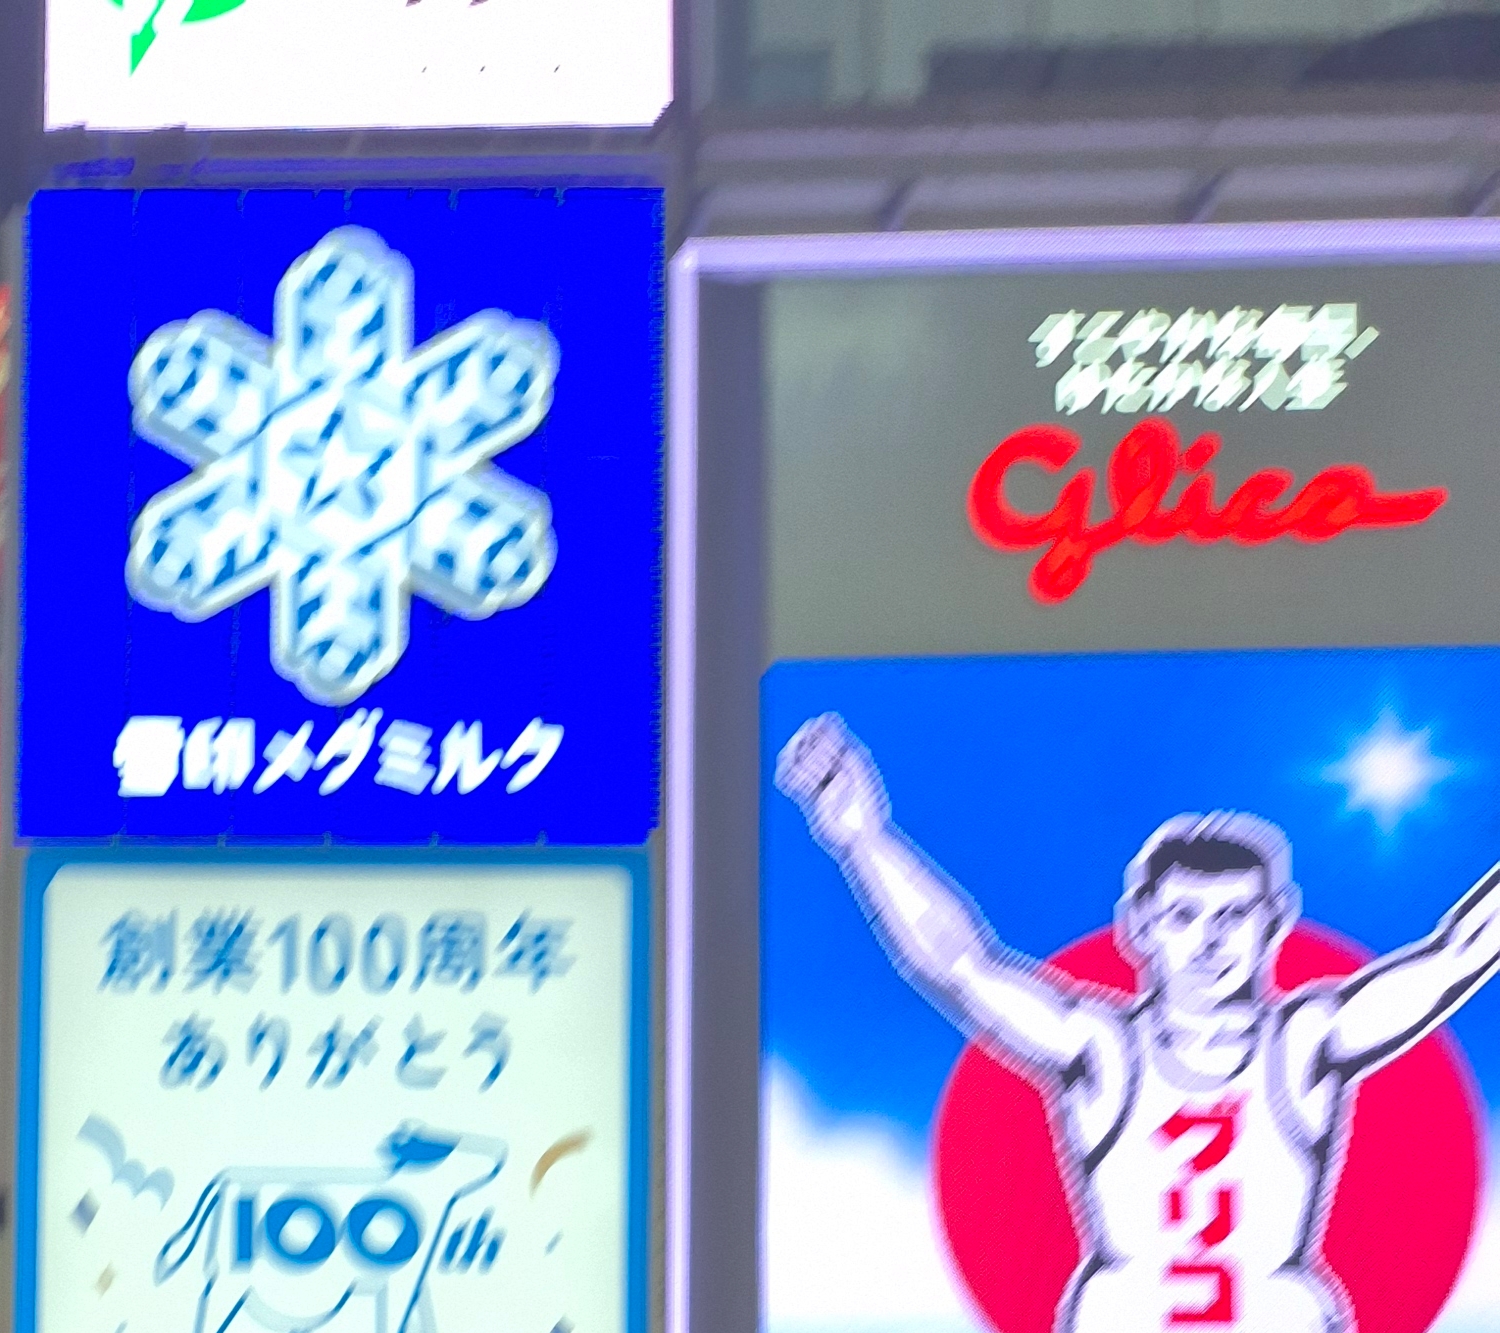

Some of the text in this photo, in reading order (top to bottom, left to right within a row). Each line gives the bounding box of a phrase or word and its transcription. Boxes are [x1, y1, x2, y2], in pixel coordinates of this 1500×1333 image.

[967, 417, 1449, 604] Glico
[114, 709, 564, 797] 雪印メグミルク
[99, 907, 577, 994] 創業100周年
[158, 1010, 513, 1093] ありがとう
[229, 1194, 507, 1275] 100th
[1154, 1094, 1244, 1330] グリコ
